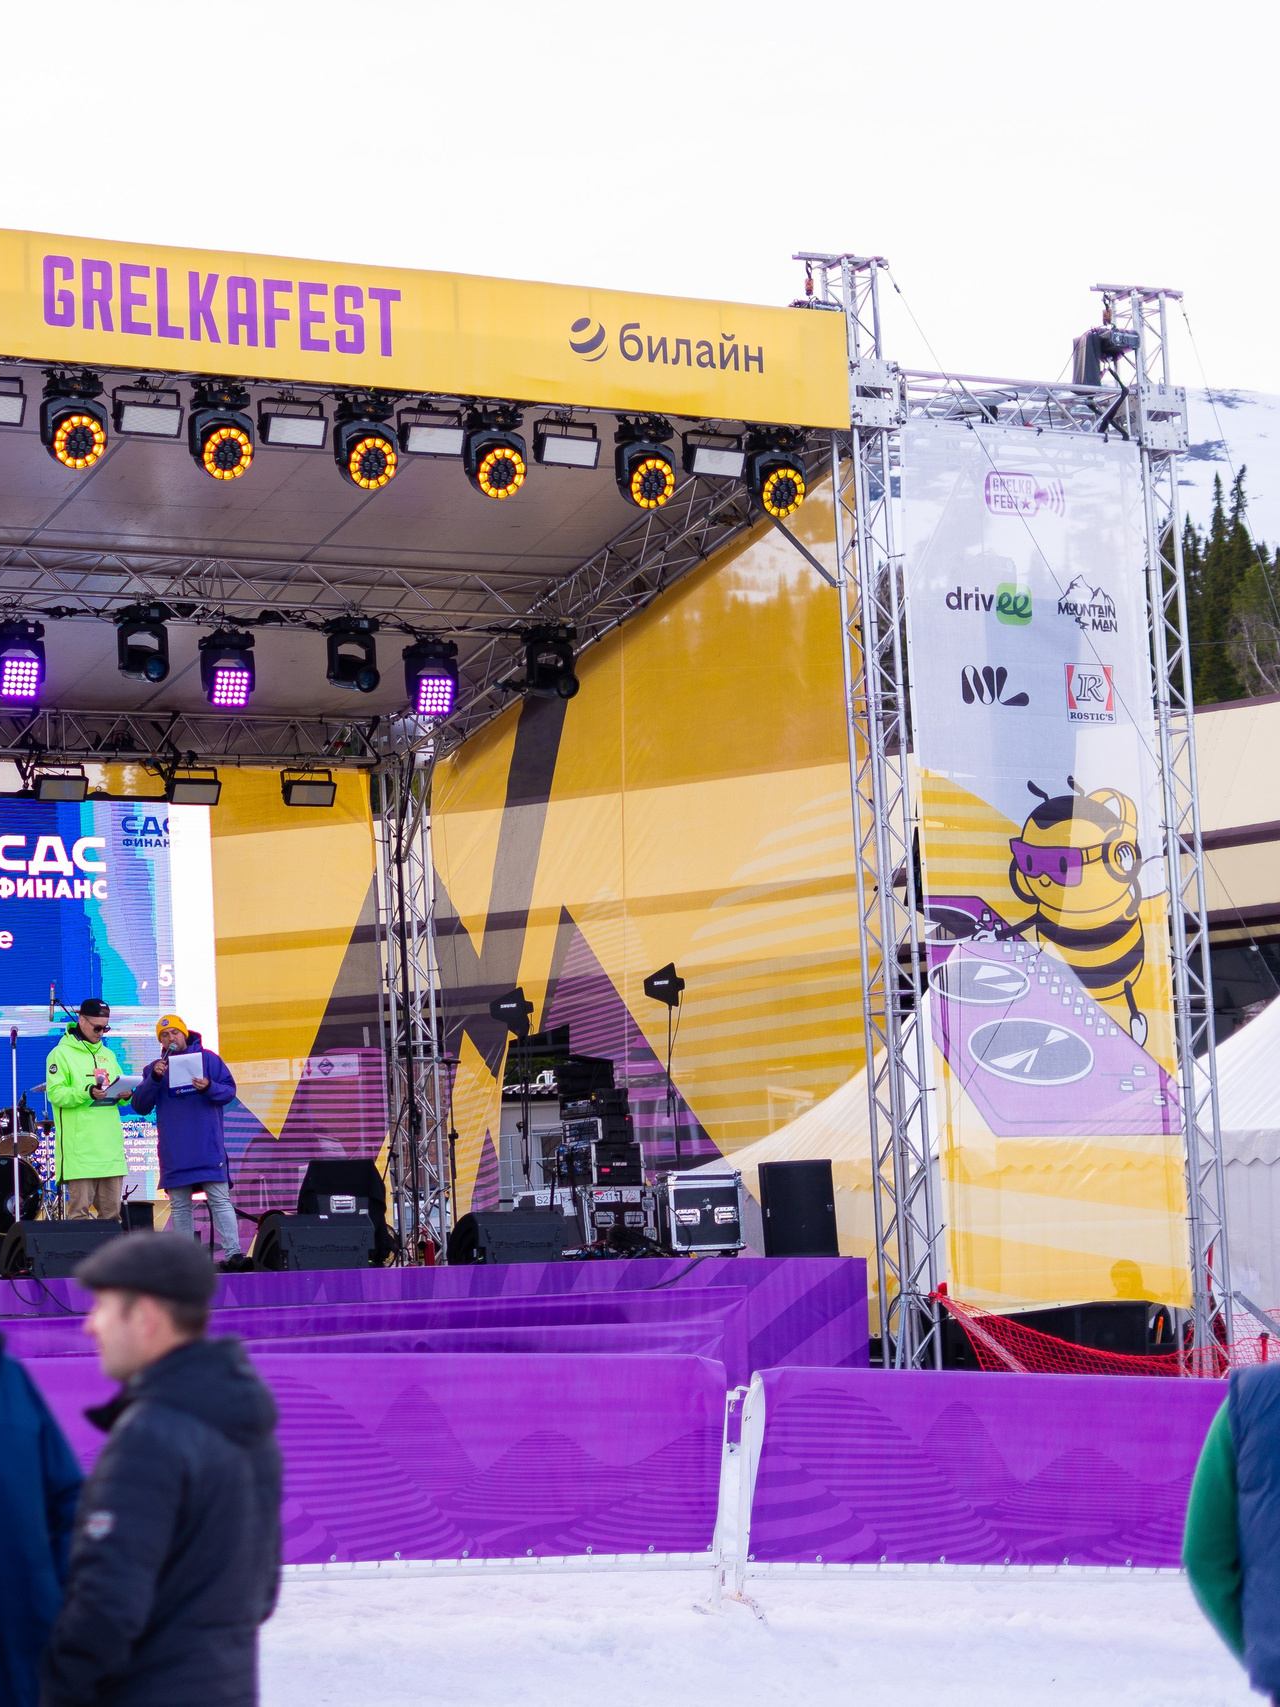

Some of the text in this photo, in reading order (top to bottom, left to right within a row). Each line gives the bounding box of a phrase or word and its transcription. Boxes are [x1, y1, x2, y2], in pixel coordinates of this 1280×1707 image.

[42, 254, 402, 358] GRELKAFEST
[619, 322, 764, 374] билайн
[992, 477, 1032, 495] GRELKA
[993, 493, 1019, 510] FEST
[945, 586, 1033, 619] drivee
[1057, 601, 1116, 619] MOUNTAIN
[1091, 618, 1118, 633] MAN
[1070, 711, 1114, 721] ROSTIC'S
[122, 838, 171, 848] ФИНАН
[536, 1195, 559, 1205] S21
